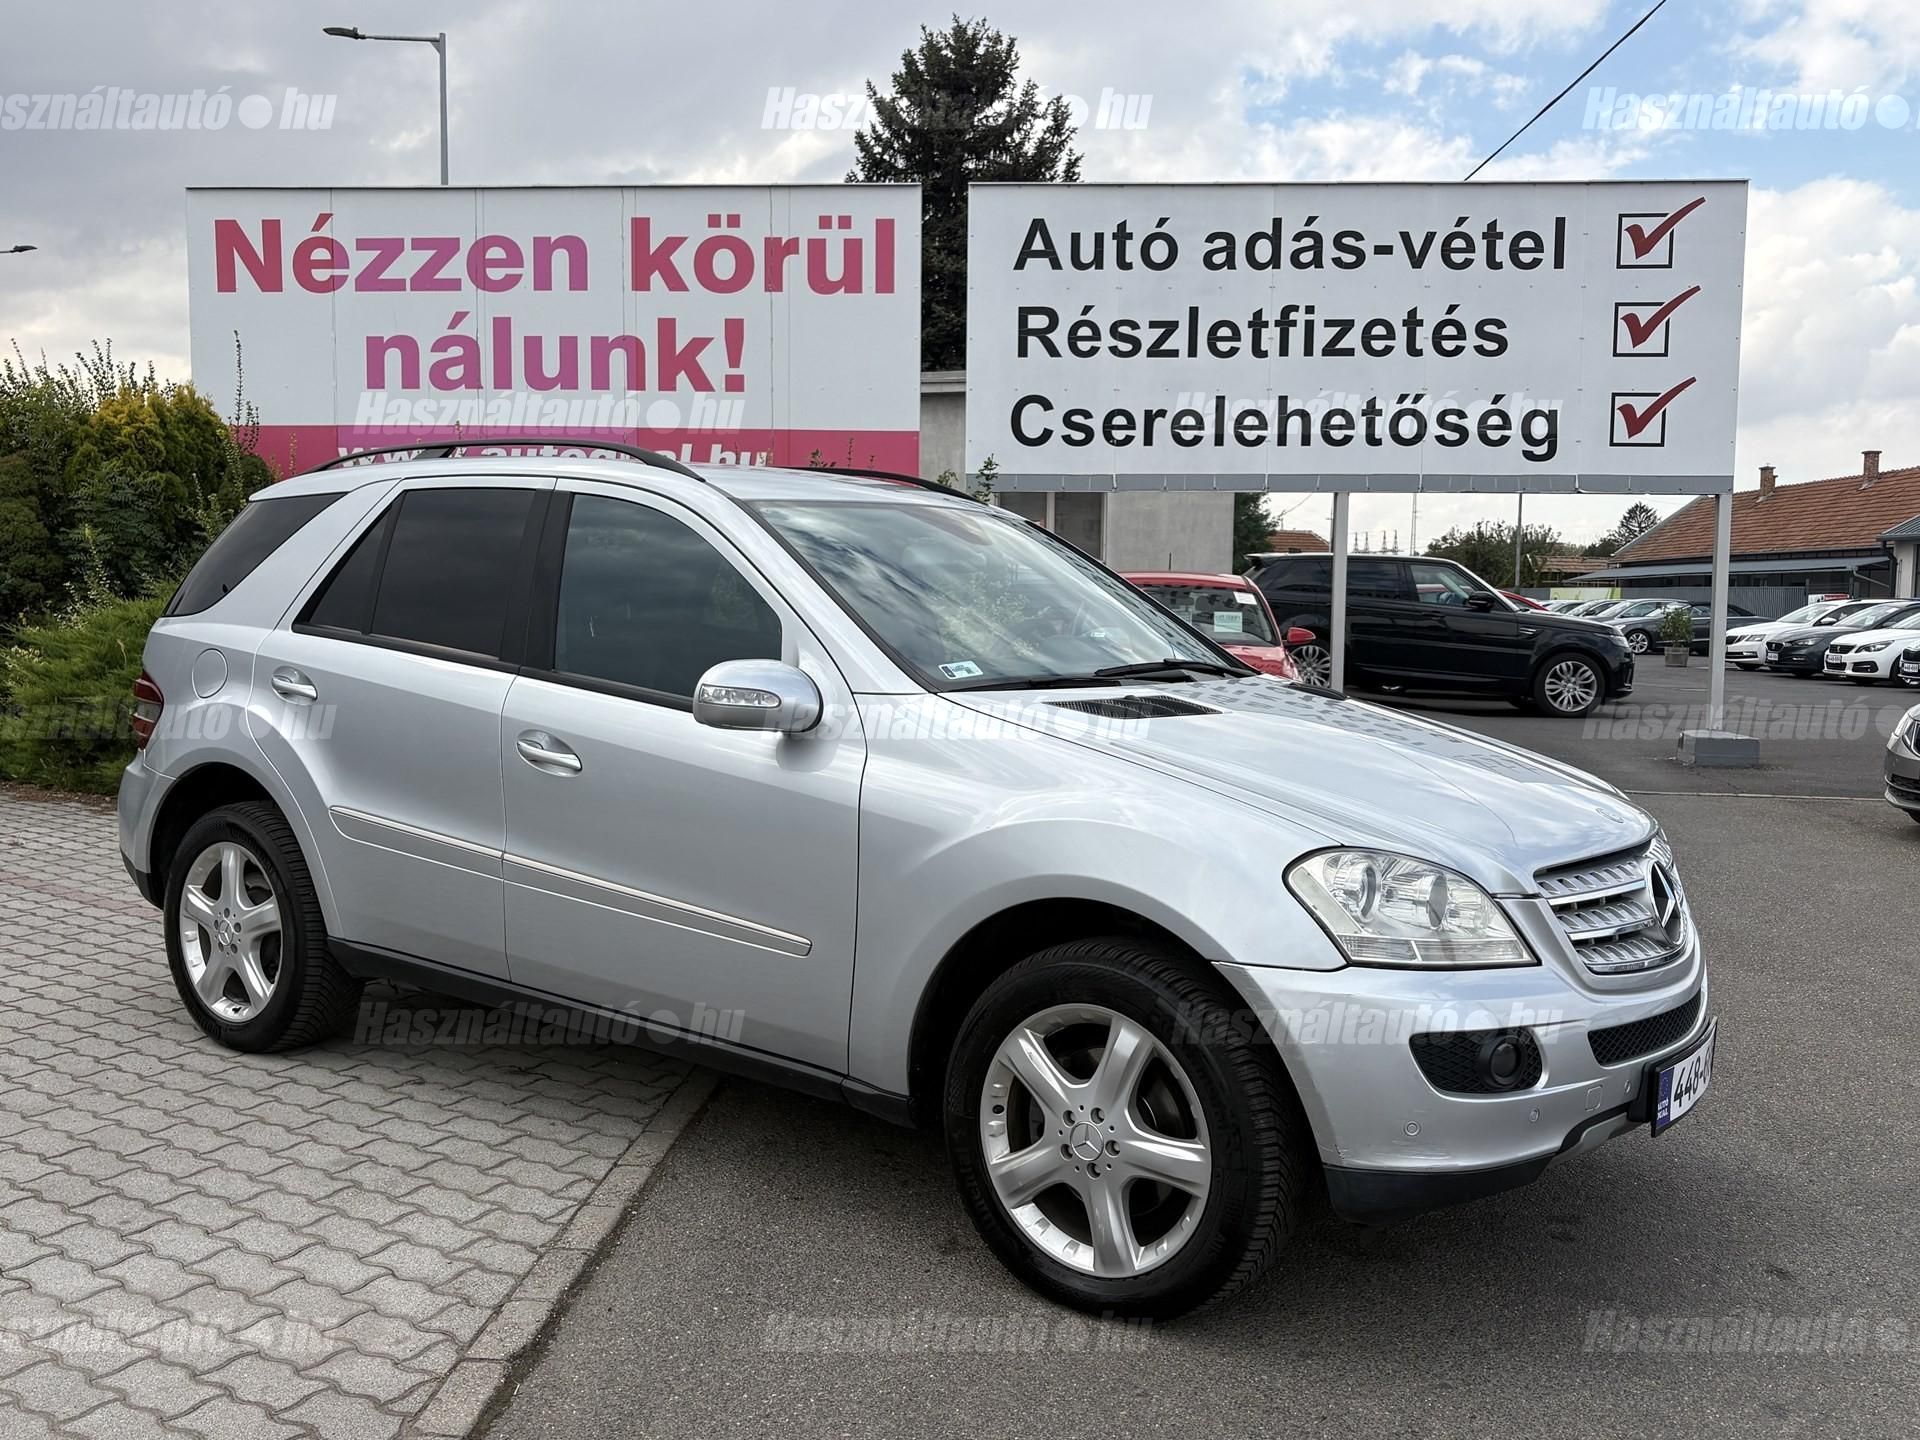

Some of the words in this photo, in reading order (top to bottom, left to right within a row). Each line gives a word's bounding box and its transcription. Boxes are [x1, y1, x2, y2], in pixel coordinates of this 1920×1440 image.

[214, 212, 589, 294] Nézzen
[631, 213, 896, 295] körül
[1013, 216, 1179, 272] Autó
[1203, 215, 1566, 272] adás-vétel
[365, 310, 746, 394] nálunk!
[1016, 303, 1509, 360] Részletfizetés
[1010, 392, 1560, 463] Cserelehetőség
